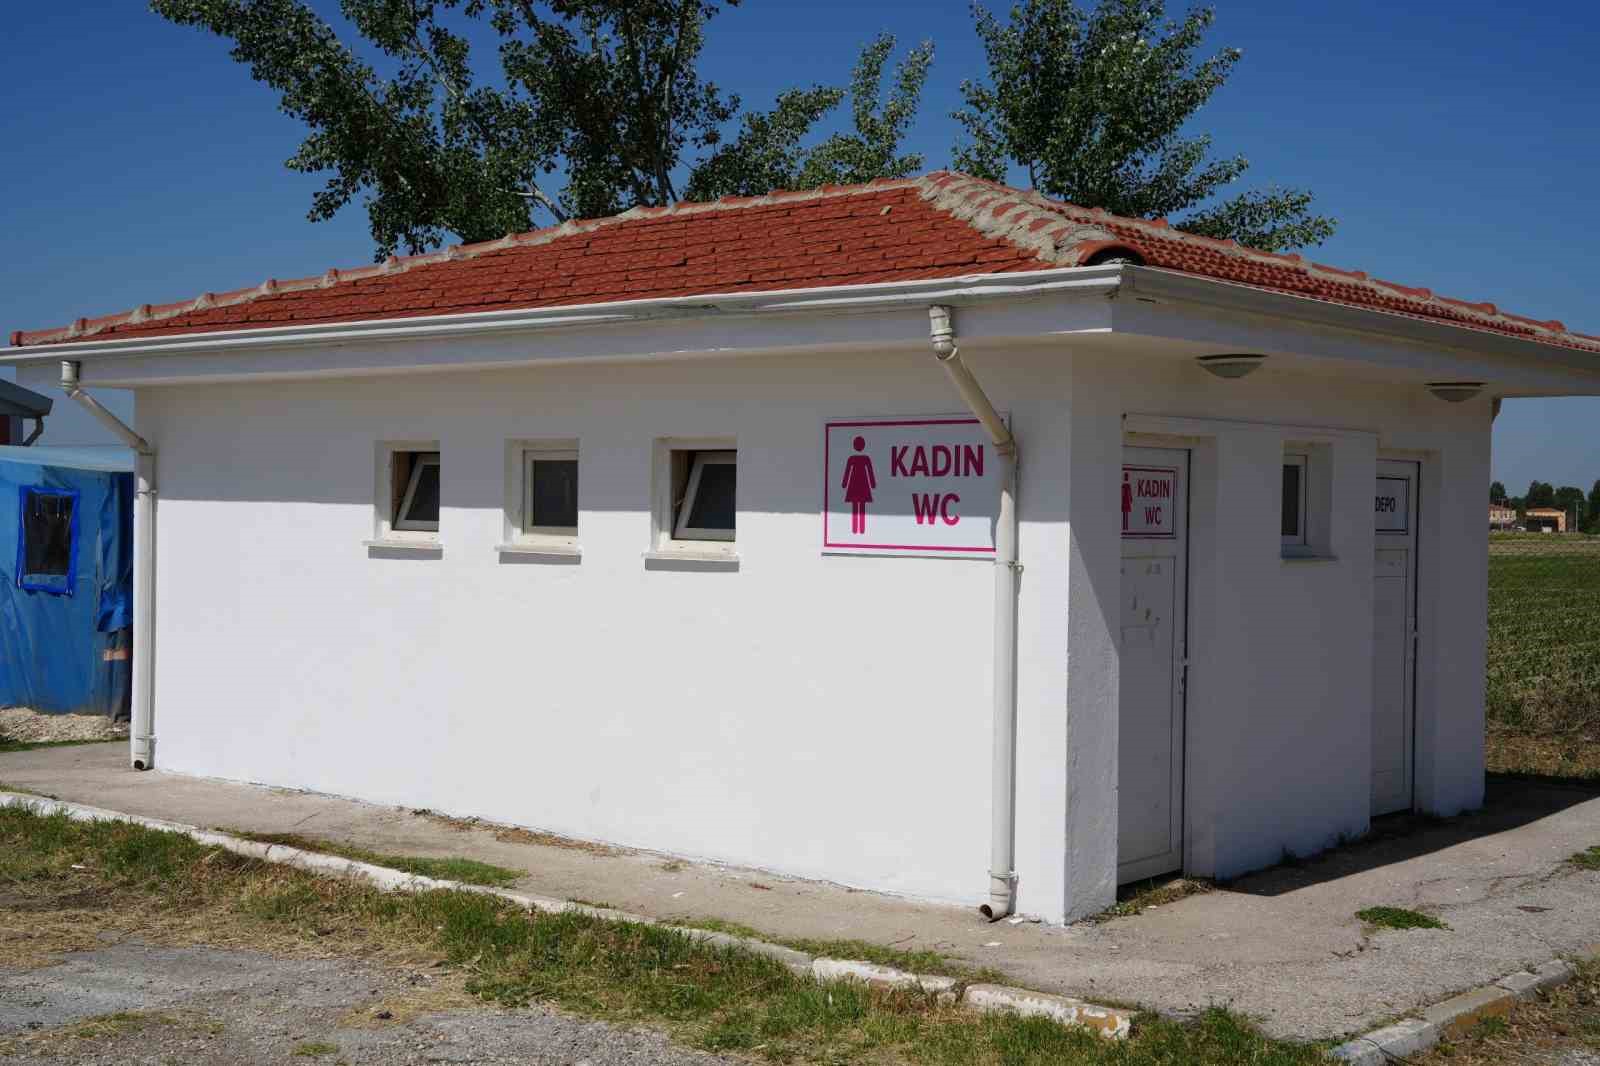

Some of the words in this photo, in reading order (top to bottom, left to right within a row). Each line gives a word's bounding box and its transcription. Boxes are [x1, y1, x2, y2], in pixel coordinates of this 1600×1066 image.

[890, 444, 984, 477] KADIN
[1137, 479, 1170, 498] KADIN
[912, 492, 961, 526] WC
[1144, 506, 1162, 525] WC
